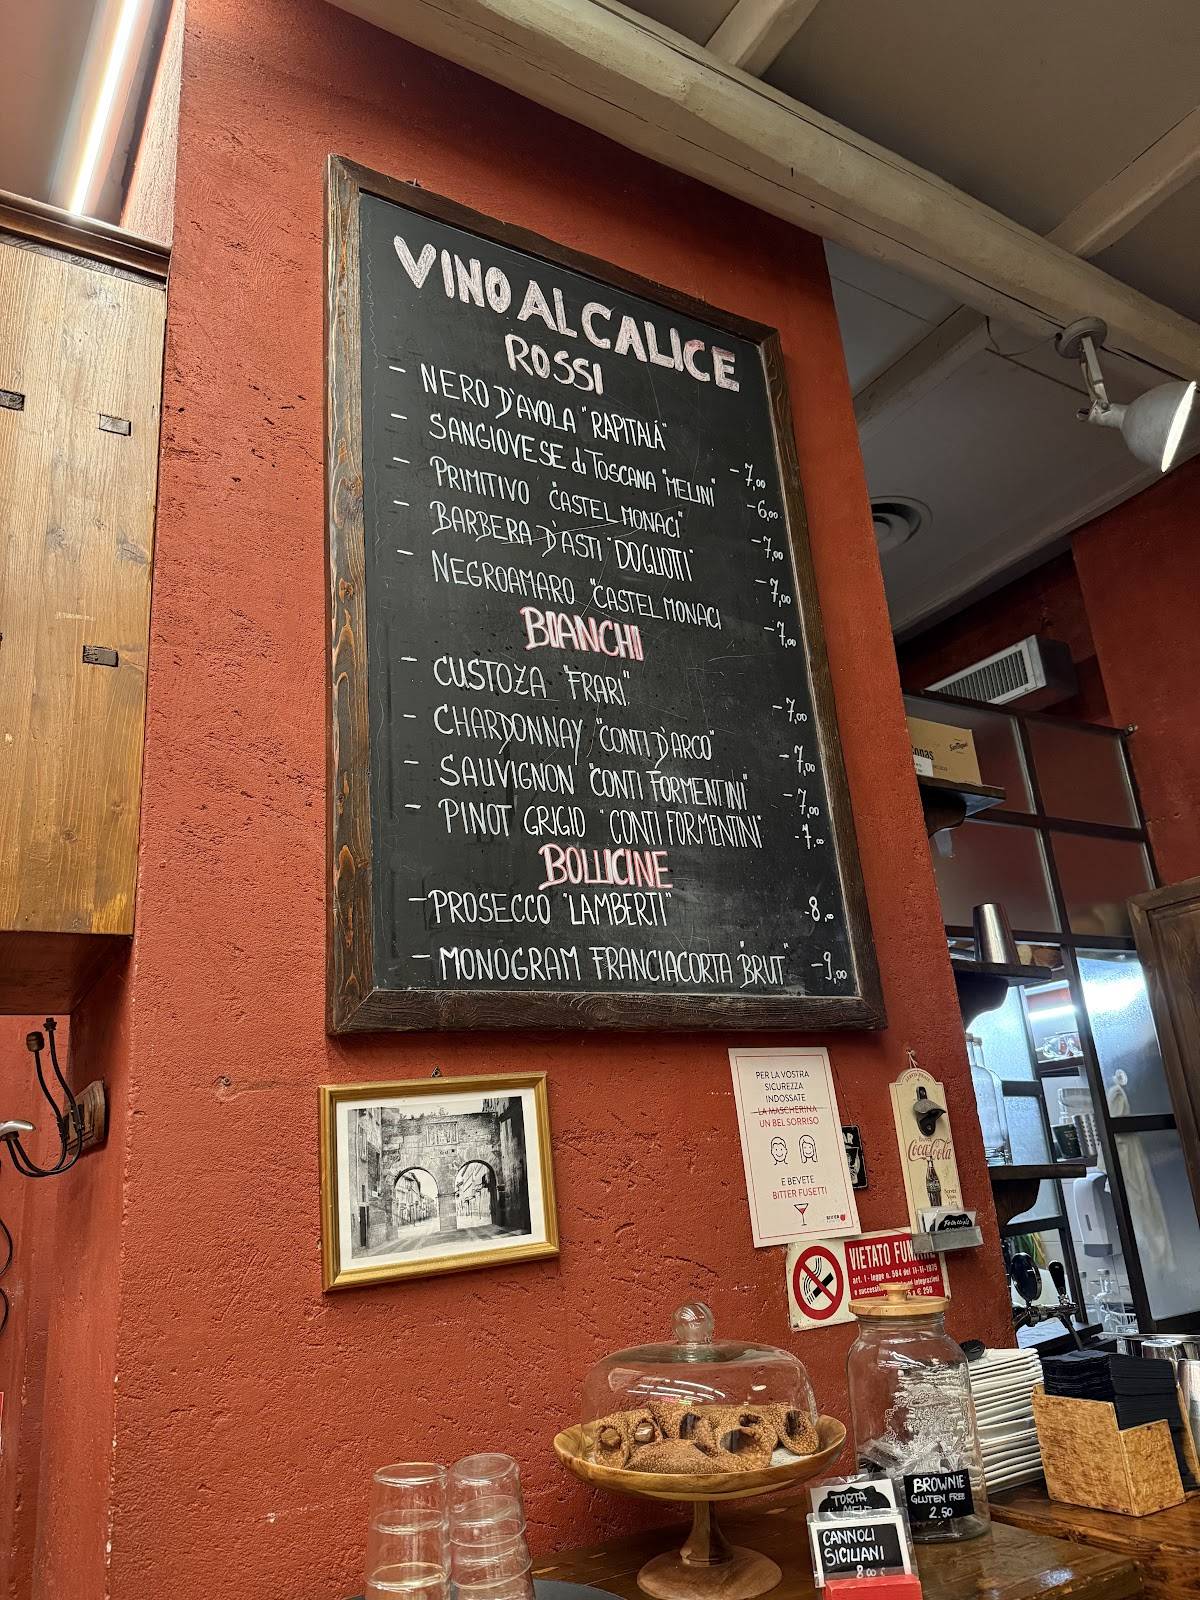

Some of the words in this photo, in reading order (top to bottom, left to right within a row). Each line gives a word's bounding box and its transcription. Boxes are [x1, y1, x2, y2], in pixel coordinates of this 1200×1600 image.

[393, 235, 512, 313] VINO
[517, 279, 578, 338] AL
[582, 301, 740, 392] CALICE
[504, 334, 604, 395] ROSSI
[421, 363, 490, 408] NERO
[494, 385, 576, 434] D'AVOLA
[429, 413, 566, 470] SANGIOVESE
[571, 447, 586, 474] di
[584, 448, 657, 493] TOSCANA
[429, 455, 530, 505] PRIMITIVO
[430, 501, 533, 546] BARBERA
[535, 520, 603, 562] D'ASTI
[431, 550, 575, 605] NEGROAMARO
[663, 597, 722, 631] MONACI
[519, 606, 645, 661] BIANCHI
[433, 656, 548, 699] CUSTOZA
[433, 704, 583, 766] CHARDONNAY
[439, 754, 575, 795] SAUVIGNON
[438, 798, 513, 837] PINOT
[523, 805, 587, 838] GRIGIO
[538, 843, 674, 891] BOLLICINE
[427, 889, 551, 925] PROSECCO
[439, 946, 581, 982] MONOGRAM
[588, 946, 734, 984] FRANCIACORTA
[755, 1071, 770, 1080] PER
[771, 1071, 780, 1080] LA
[780, 1070, 810, 1079] VOSTRA
[764, 1082, 804, 1091] SICUREZZA
[757, 1106, 767, 1115] LA
[768, 1105, 818, 1114] MASCHERINA
[766, 1094, 806, 1103] INDOSSATE
[760, 1119, 771, 1128] UN
[772, 1118, 786, 1127] BEL
[786, 1117, 820, 1126] SORRISO
[781, 1177, 787, 1186] E
[787, 1175, 815, 1186] BEVETE
[772, 1190, 798, 1200] BITTER
[798, 1187, 828, 1198] FUSETTI
[848, 1243, 891, 1270] VIETATO
[852, 1276, 862, 1284] art.
[870, 1273, 885, 1282] legge
[902, 1268, 912, 1276] del
[913, 1274, 940, 1286] integrazioni
[922, 1286, 933, 1295] 250
[913, 1474, 966, 1494] BROWNIE
[831, 1491, 868, 1507] TORTA
[911, 1494, 947, 1506] GLUTEN
[949, 1492, 966, 1502] FREE
[928, 1506, 954, 1519] 2.50
[822, 1528, 876, 1546] CANNOLI
[824, 1545, 885, 1567] SICILIANI
